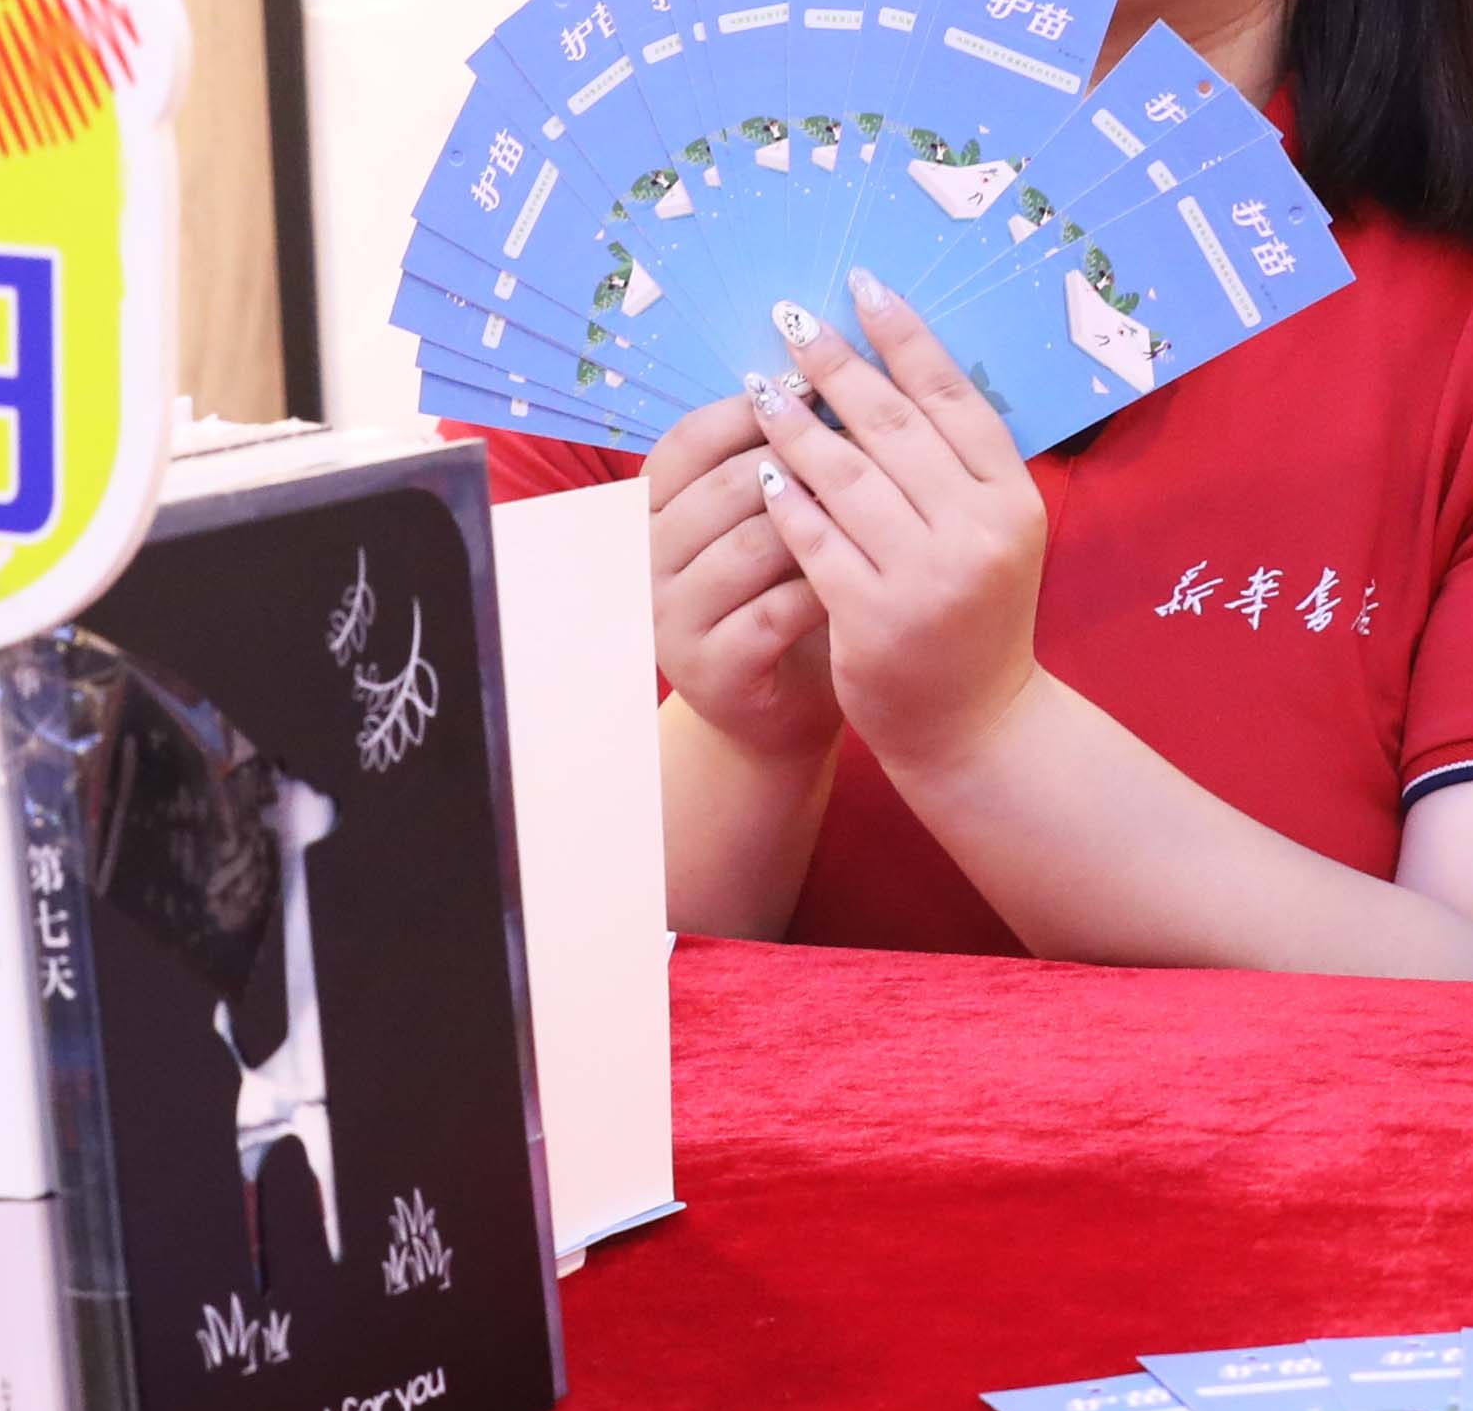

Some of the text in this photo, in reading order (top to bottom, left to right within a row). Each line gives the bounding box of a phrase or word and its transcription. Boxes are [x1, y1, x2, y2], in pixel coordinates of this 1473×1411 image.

[470, 128, 525, 213] 护苗
[1231, 199, 1297, 277] 护苗
[28, 842, 77, 1003] 第七天
